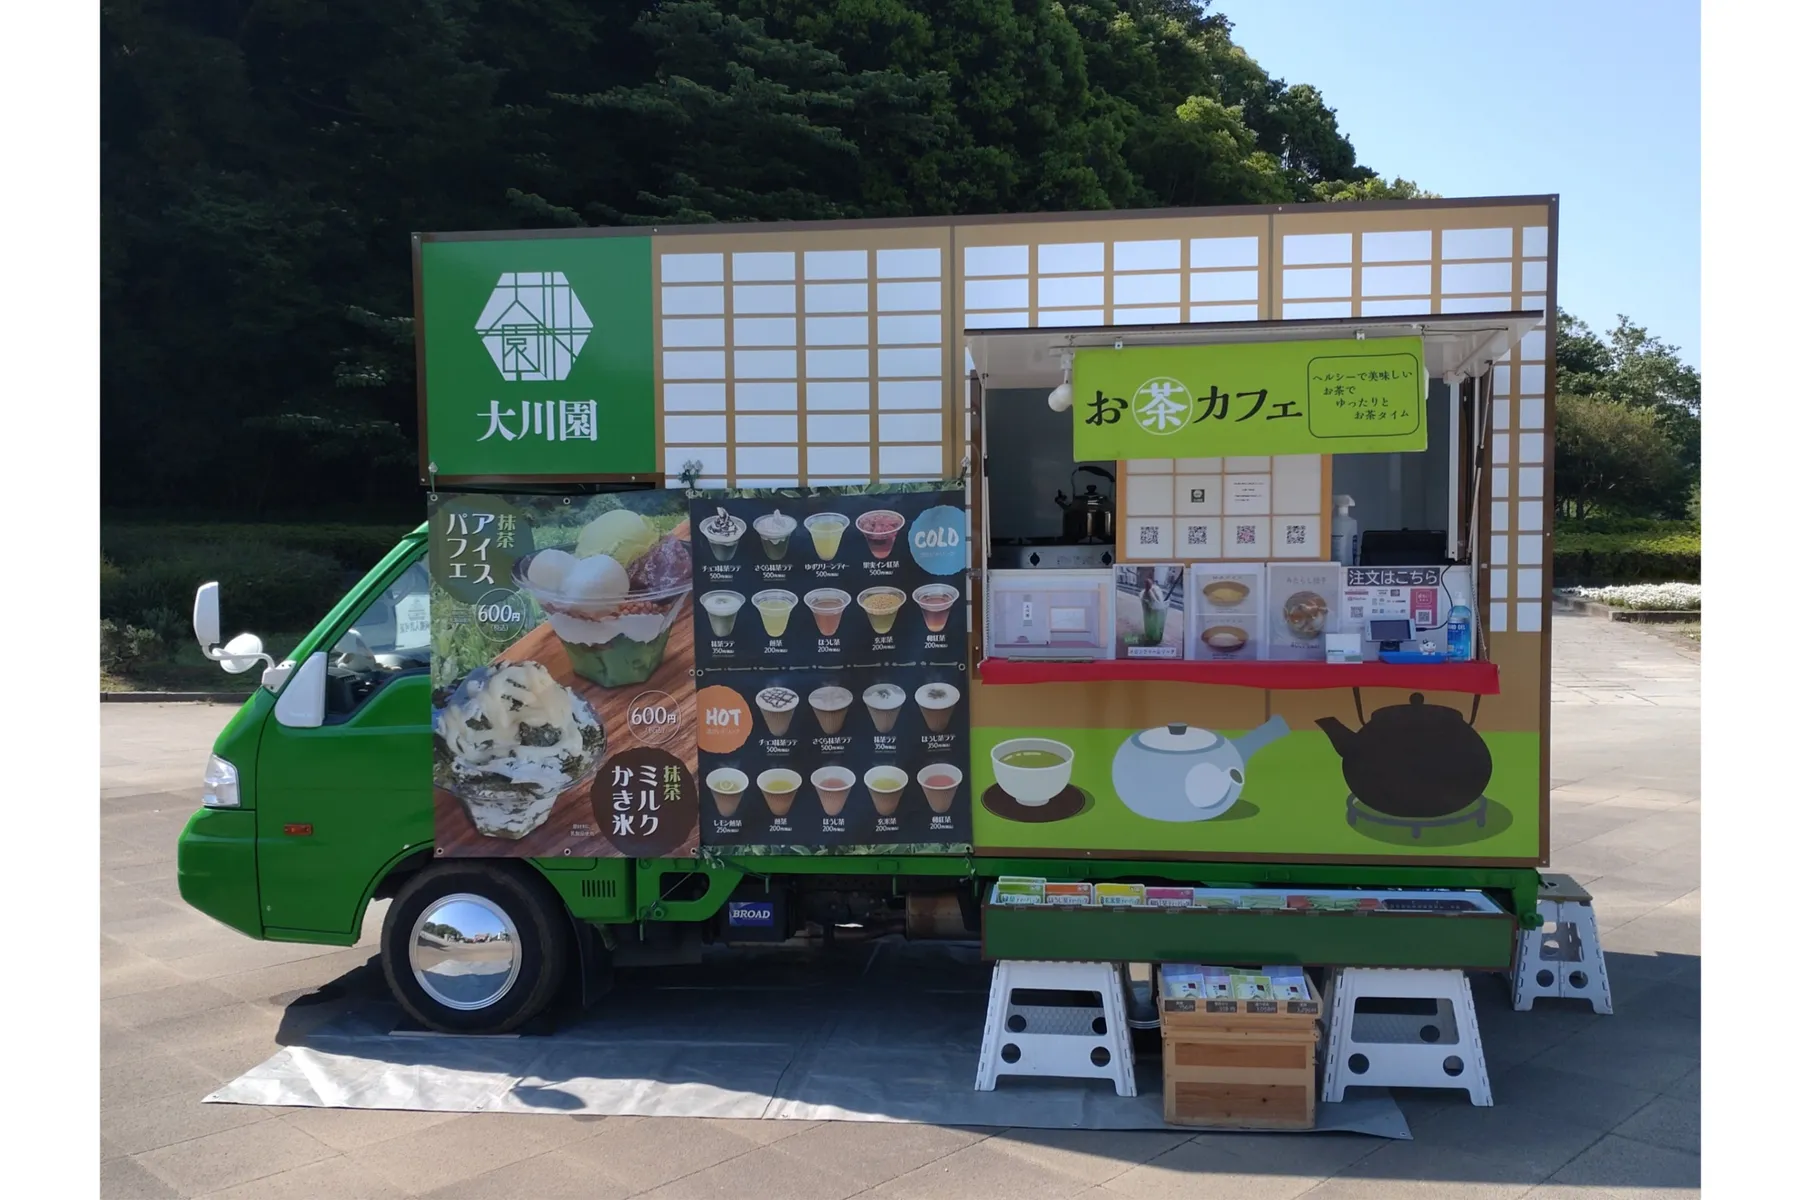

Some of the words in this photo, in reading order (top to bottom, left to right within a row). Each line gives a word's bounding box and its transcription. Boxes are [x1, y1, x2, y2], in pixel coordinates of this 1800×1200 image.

[1313, 370, 1413, 382] ヘルシーで美味しい
[1323, 385, 1356, 396] お茶で
[1085, 383, 1303, 432] お茶カフェ
[1336, 397, 1389, 408] ゆったりと
[476, 399, 597, 442] 大川園
[1354, 409, 1409, 420] お茶タイム
[496, 514, 516, 549] 抹茶
[915, 526, 959, 548] COLD
[446, 513, 469, 579] パフェ
[471, 513, 495, 585] アイス
[1349, 570, 1438, 586] 注文はこちら
[478, 604, 521, 622] 600円
[631, 706, 676, 725] 600円
[706, 708, 742, 726] HOT
[663, 765, 681, 801] 抹茶
[612, 765, 635, 836] かき氷
[637, 765, 660, 837] ミルク
[733, 909, 771, 919] BROAD
